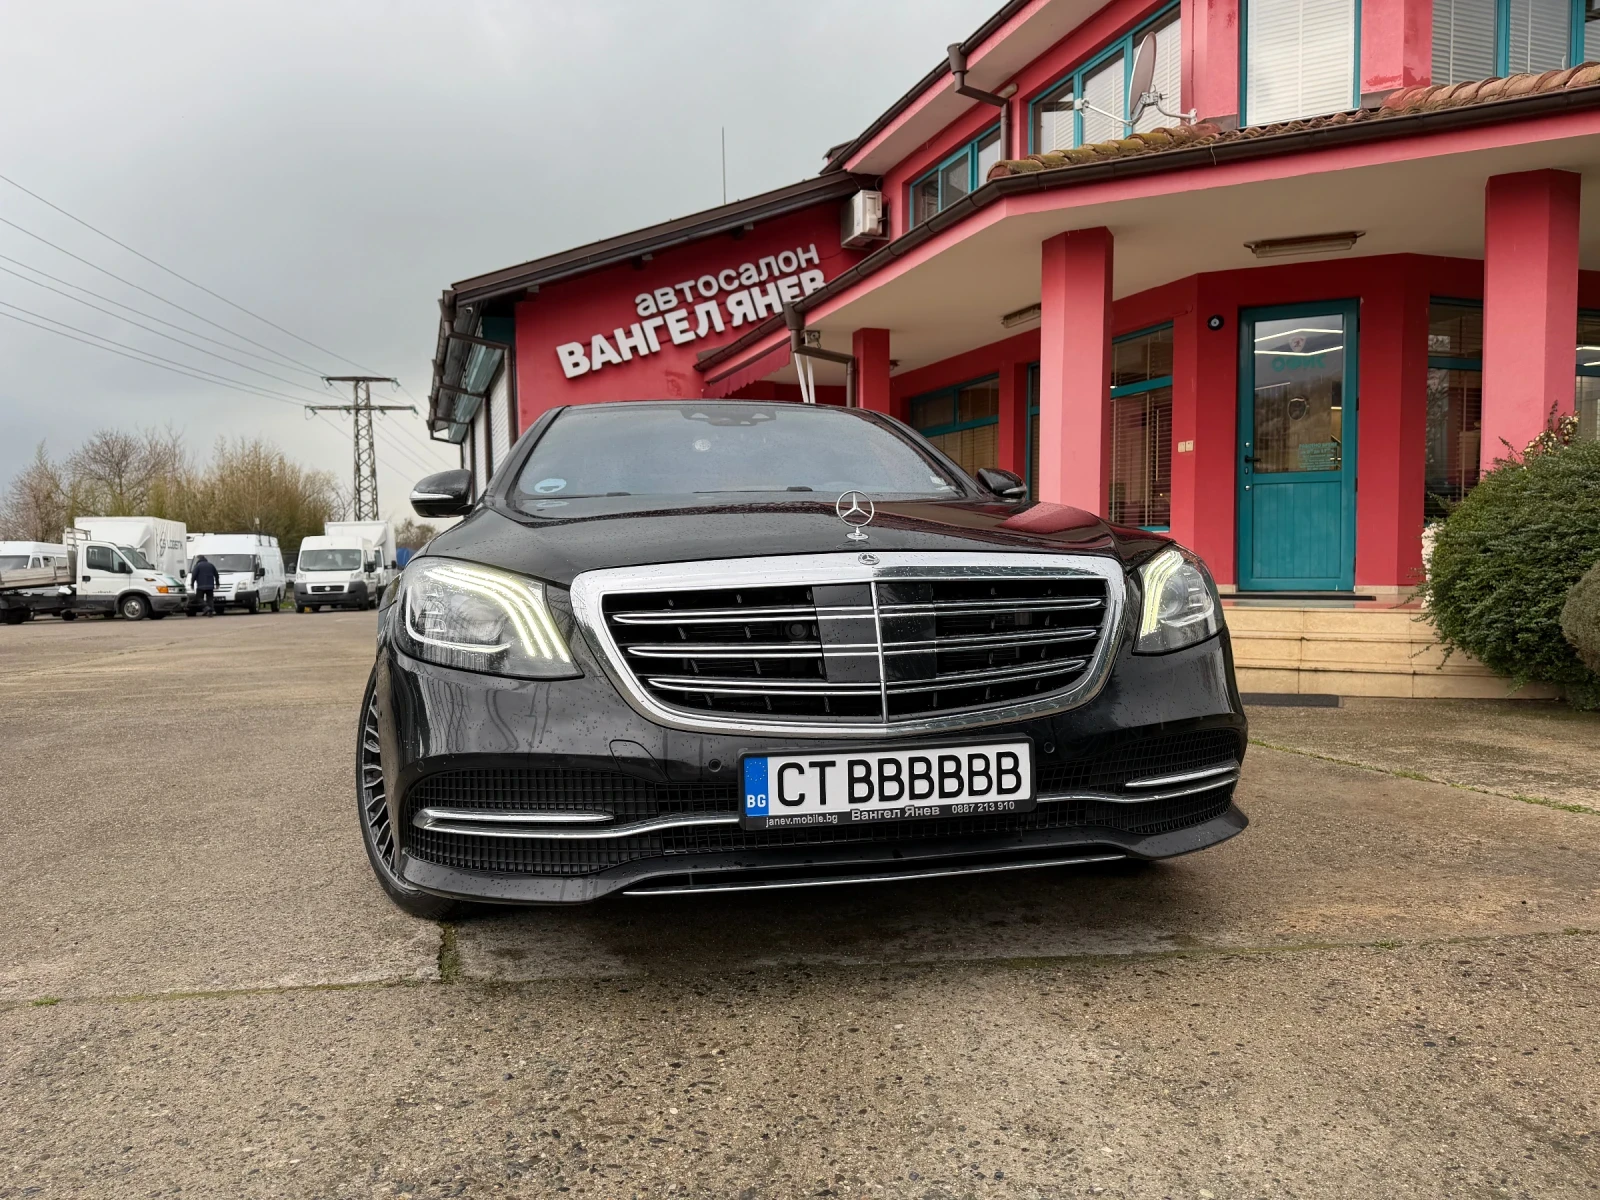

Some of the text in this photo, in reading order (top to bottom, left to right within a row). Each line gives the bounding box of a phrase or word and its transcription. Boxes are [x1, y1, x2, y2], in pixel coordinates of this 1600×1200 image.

[635, 243, 820, 317] автосалон
[556, 269, 828, 379] ВАНГЕЛ ЯНЕВ
[746, 794, 767, 808] BG
[777, 751, 1022, 807] CT BBBBBB
[766, 801, 1015, 828] janev.mobile.bg Вангел Янев 0887 213 910
